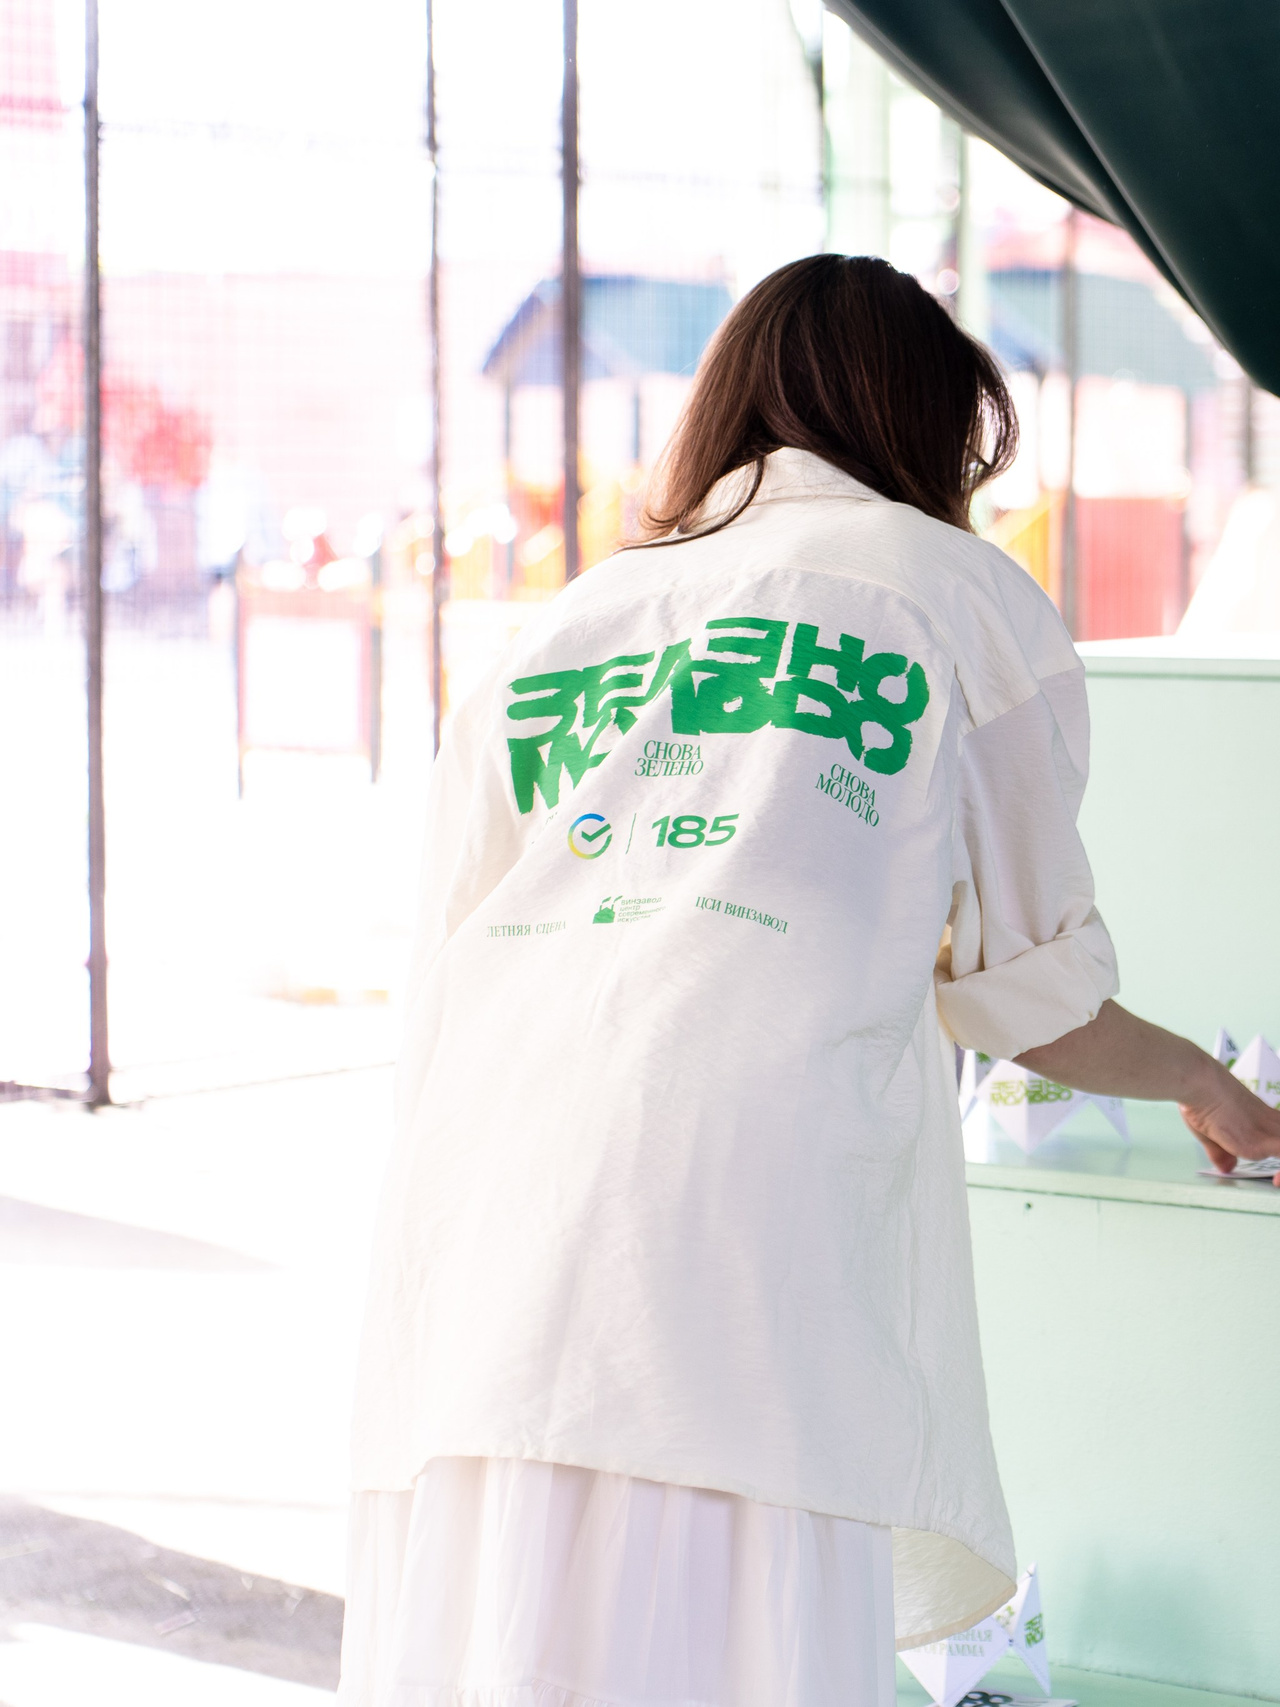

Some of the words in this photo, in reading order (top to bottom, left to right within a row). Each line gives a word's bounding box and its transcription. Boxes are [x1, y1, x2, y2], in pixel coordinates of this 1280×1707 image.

[634, 757, 704, 777] ЗЕЛЕНО
[643, 739, 701, 760] СНОВА
[814, 772, 880, 827] МОЛОДО
[830, 763, 876, 807] СНОВА
[651, 813, 740, 849] 185
[486, 924, 531, 938] ЛЕТНЯЯ
[535, 921, 567, 935] СЦЕНА
[695, 896, 722, 912] ЦСИ
[723, 902, 789, 934] ВИНЗАВОД
